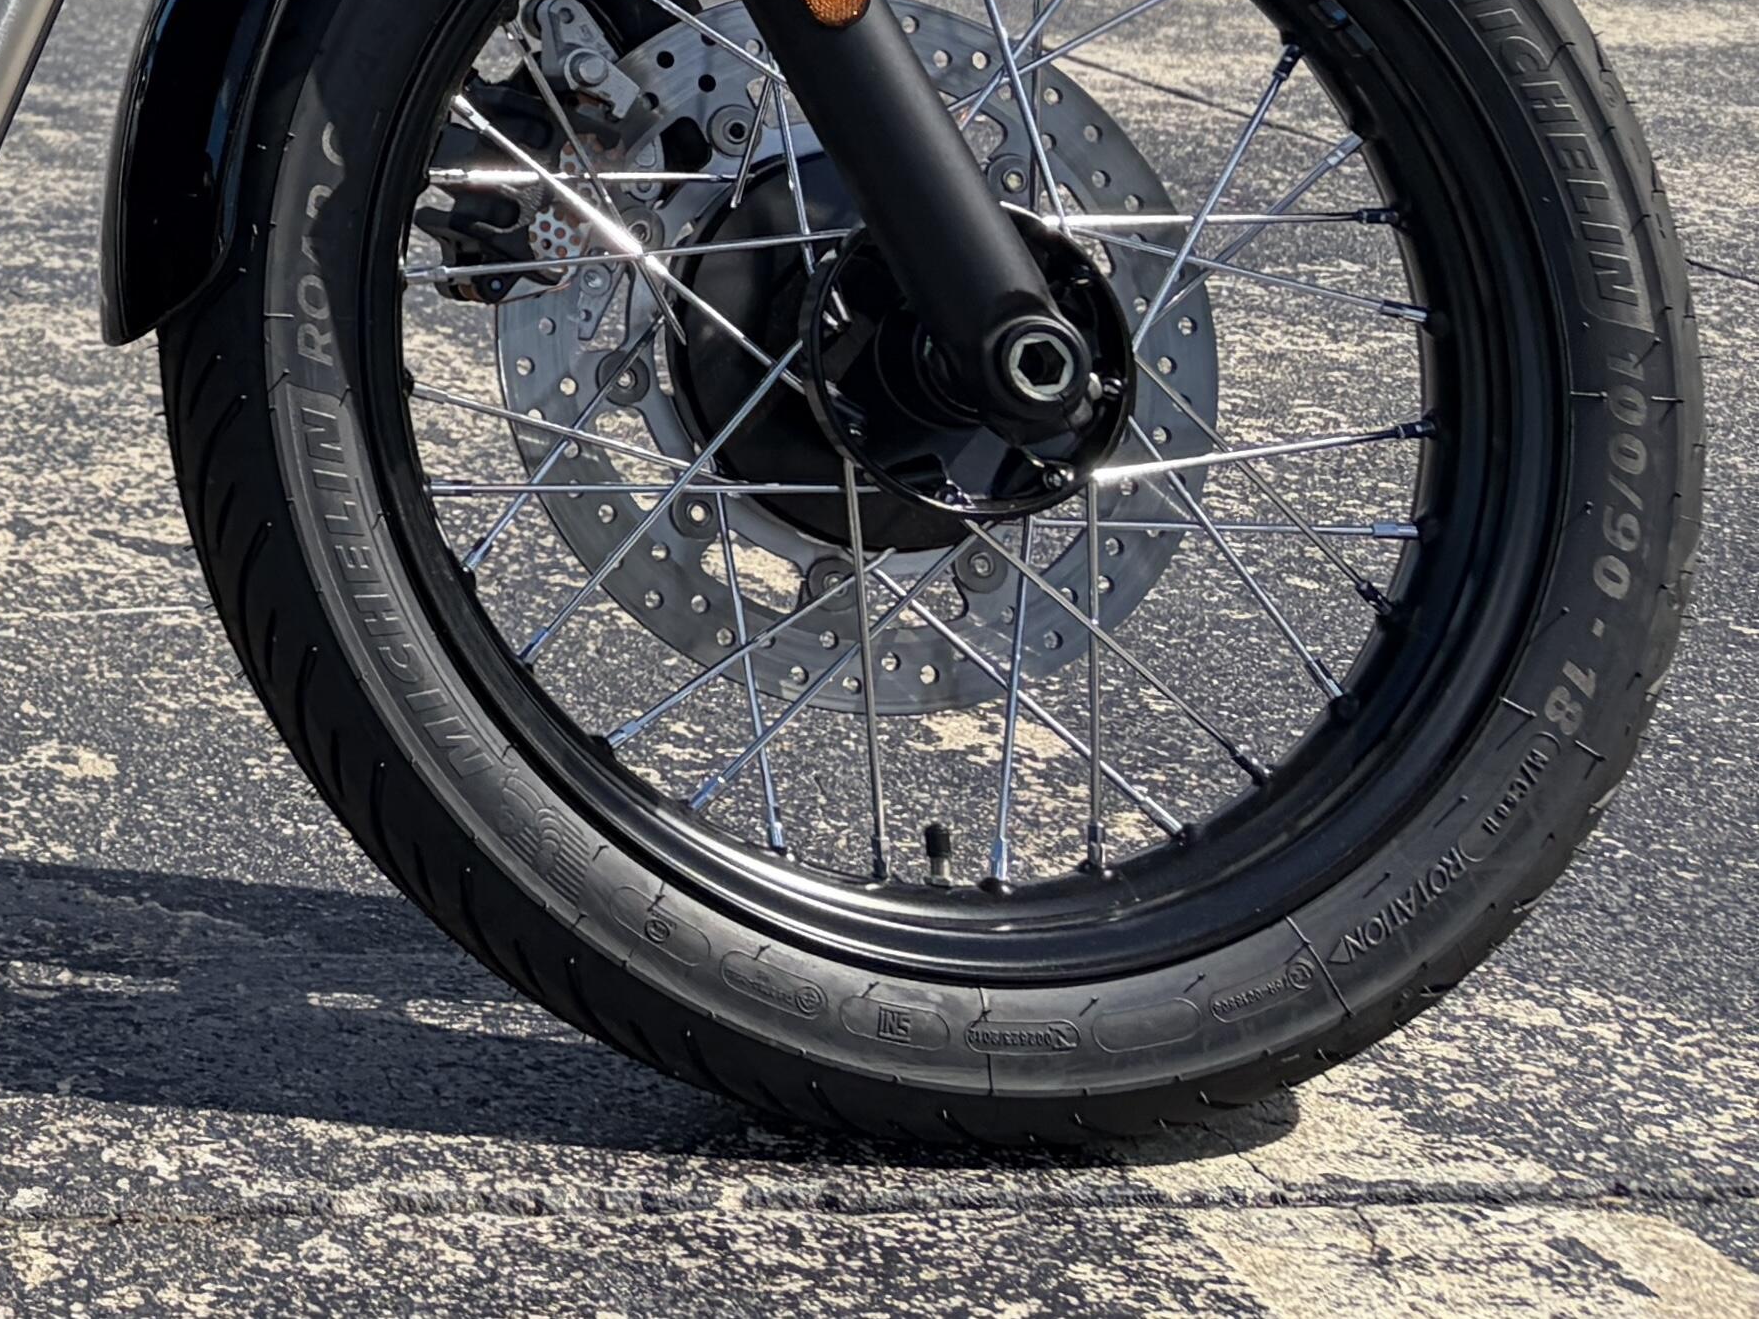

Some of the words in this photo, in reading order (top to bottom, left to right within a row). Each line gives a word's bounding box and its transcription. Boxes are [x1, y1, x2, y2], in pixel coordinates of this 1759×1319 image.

[1588, 351, 1644, 602] 100/90
[301, 406, 495, 778] MICHELIN
[1538, 659, 1595, 739] 18
[1335, 844, 1465, 959] ROTATION
